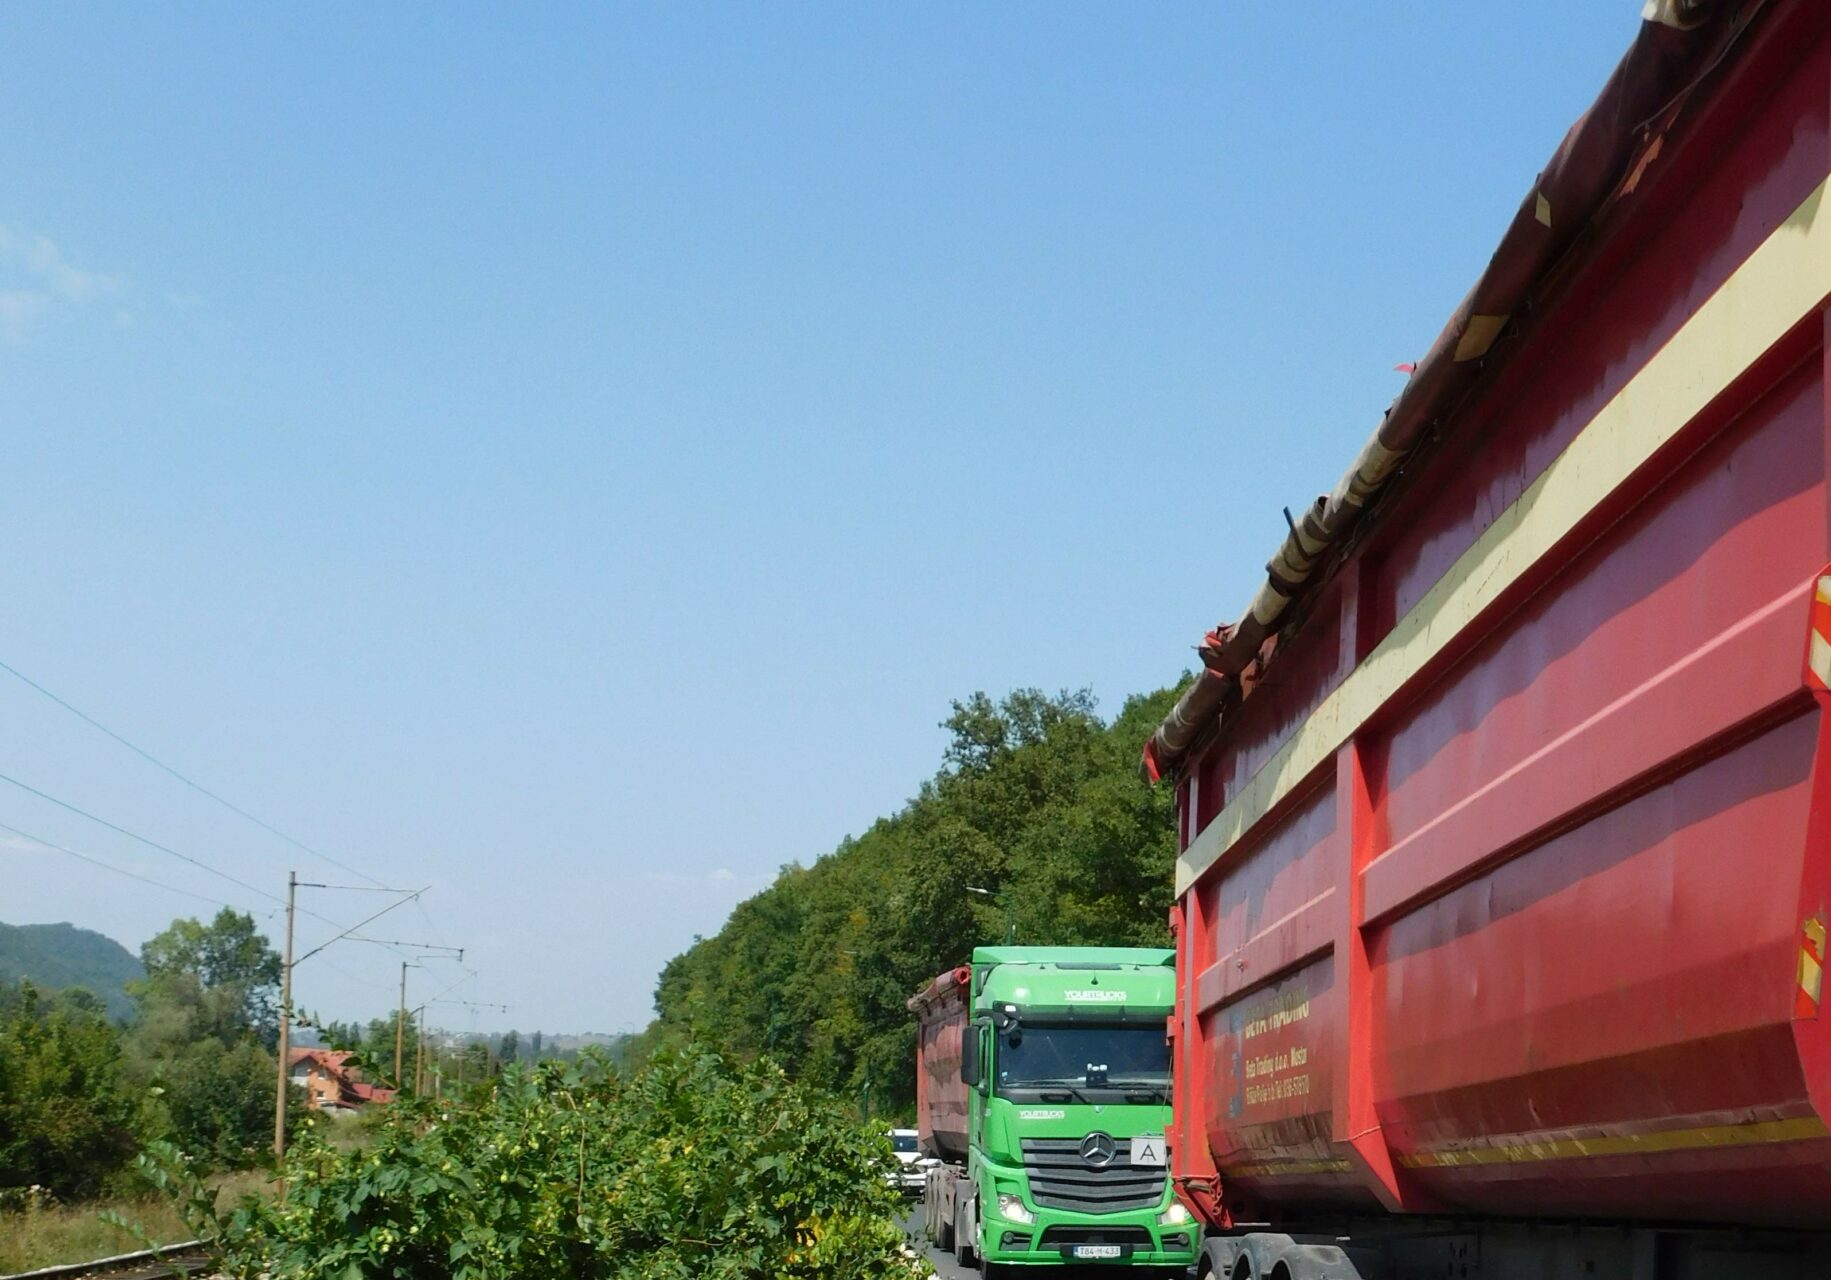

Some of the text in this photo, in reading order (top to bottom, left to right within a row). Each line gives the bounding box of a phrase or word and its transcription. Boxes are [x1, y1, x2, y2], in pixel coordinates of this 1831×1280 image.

[1064, 990, 1127, 1001] YOURTRUCKS
[1245, 984, 1310, 1040] BETA TRADING
[1290, 1046, 1308, 1068] Mostar
[1019, 1110, 1065, 1119] YOURTRUCKS
[1139, 1143, 1157, 1161] A
